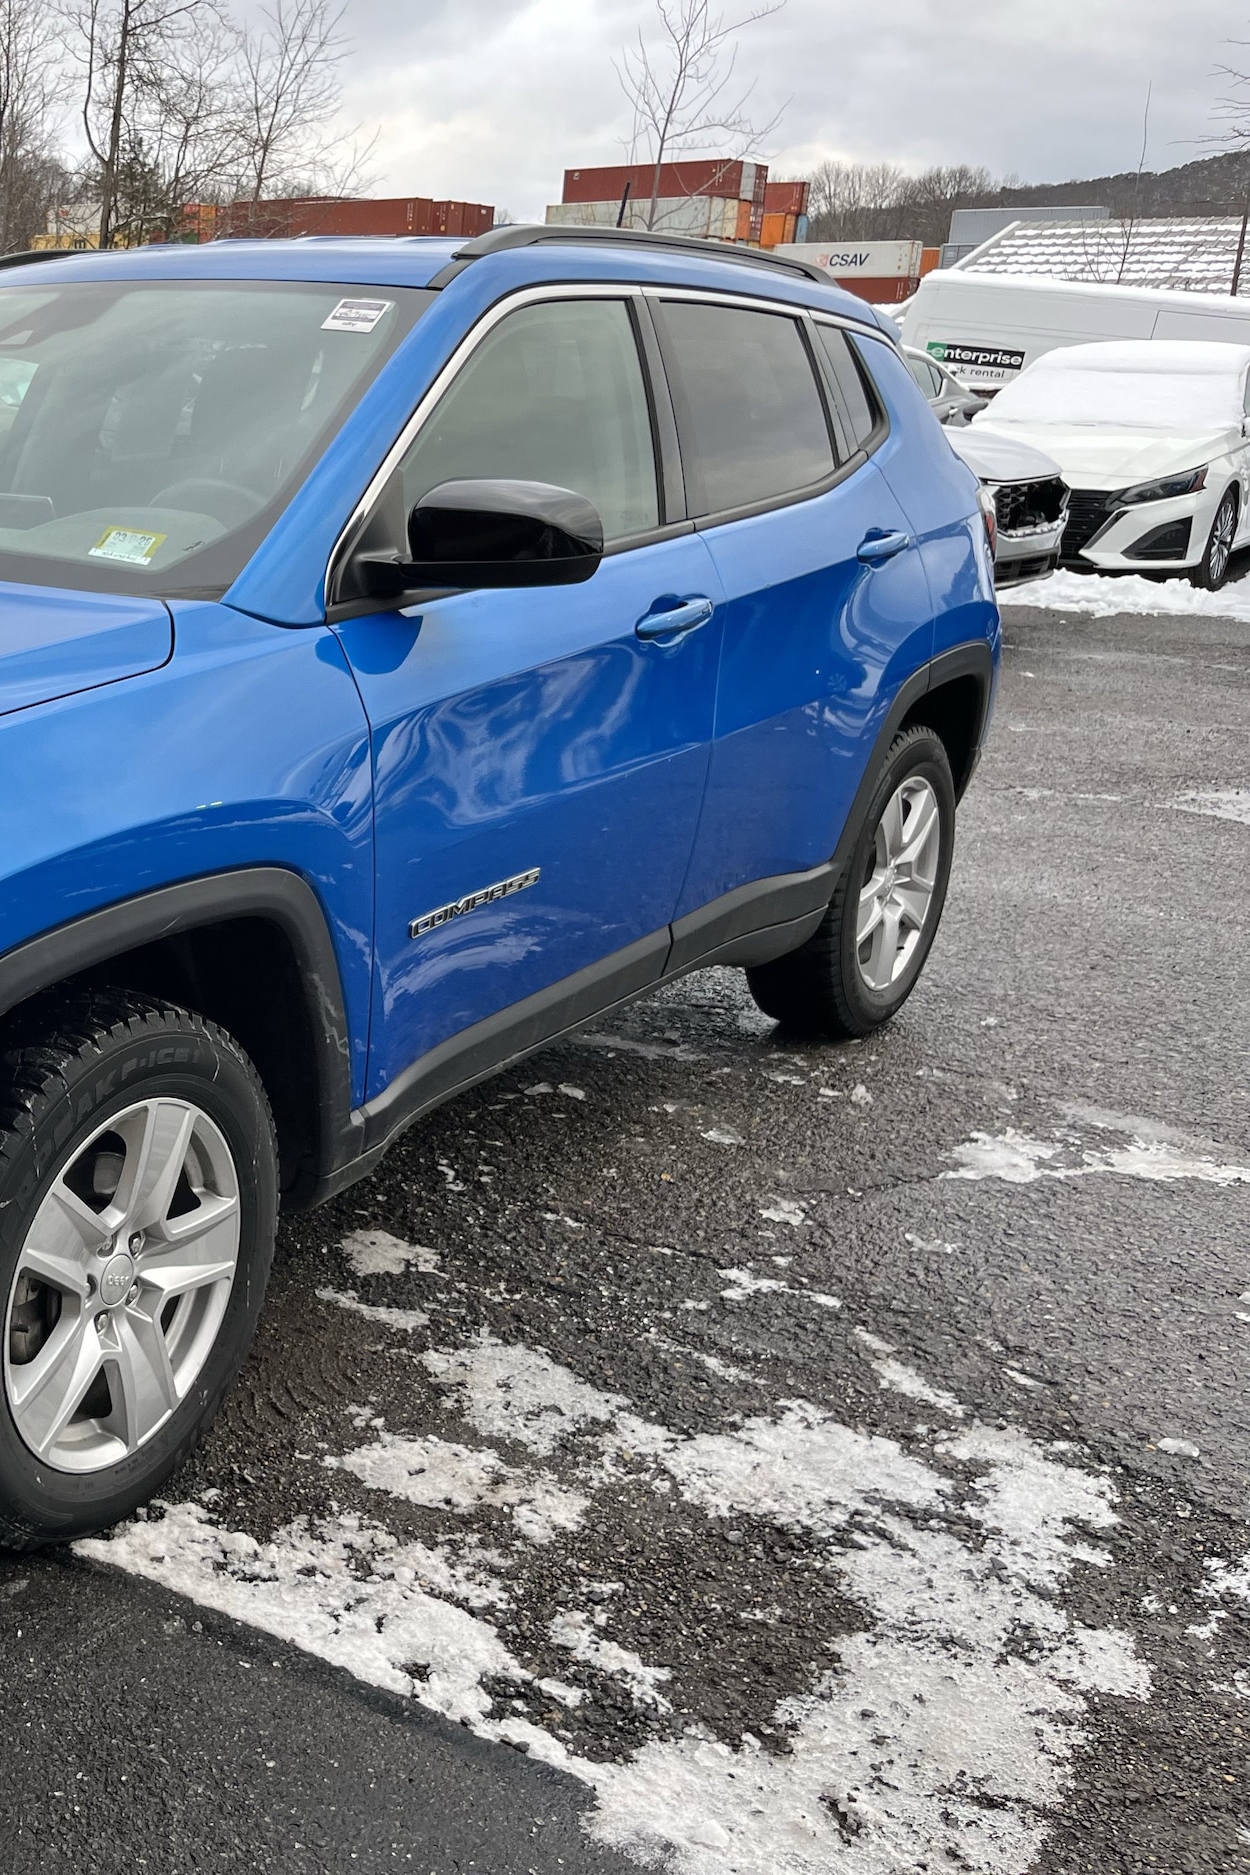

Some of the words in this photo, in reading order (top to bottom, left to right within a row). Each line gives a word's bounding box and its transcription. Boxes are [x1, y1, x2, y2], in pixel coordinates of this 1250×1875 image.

[830, 253, 870, 267] CSAV
[927, 346, 1023, 366] enterprise
[970, 368, 1005, 379] rental
[408, 866, 542, 939] COMPASS
